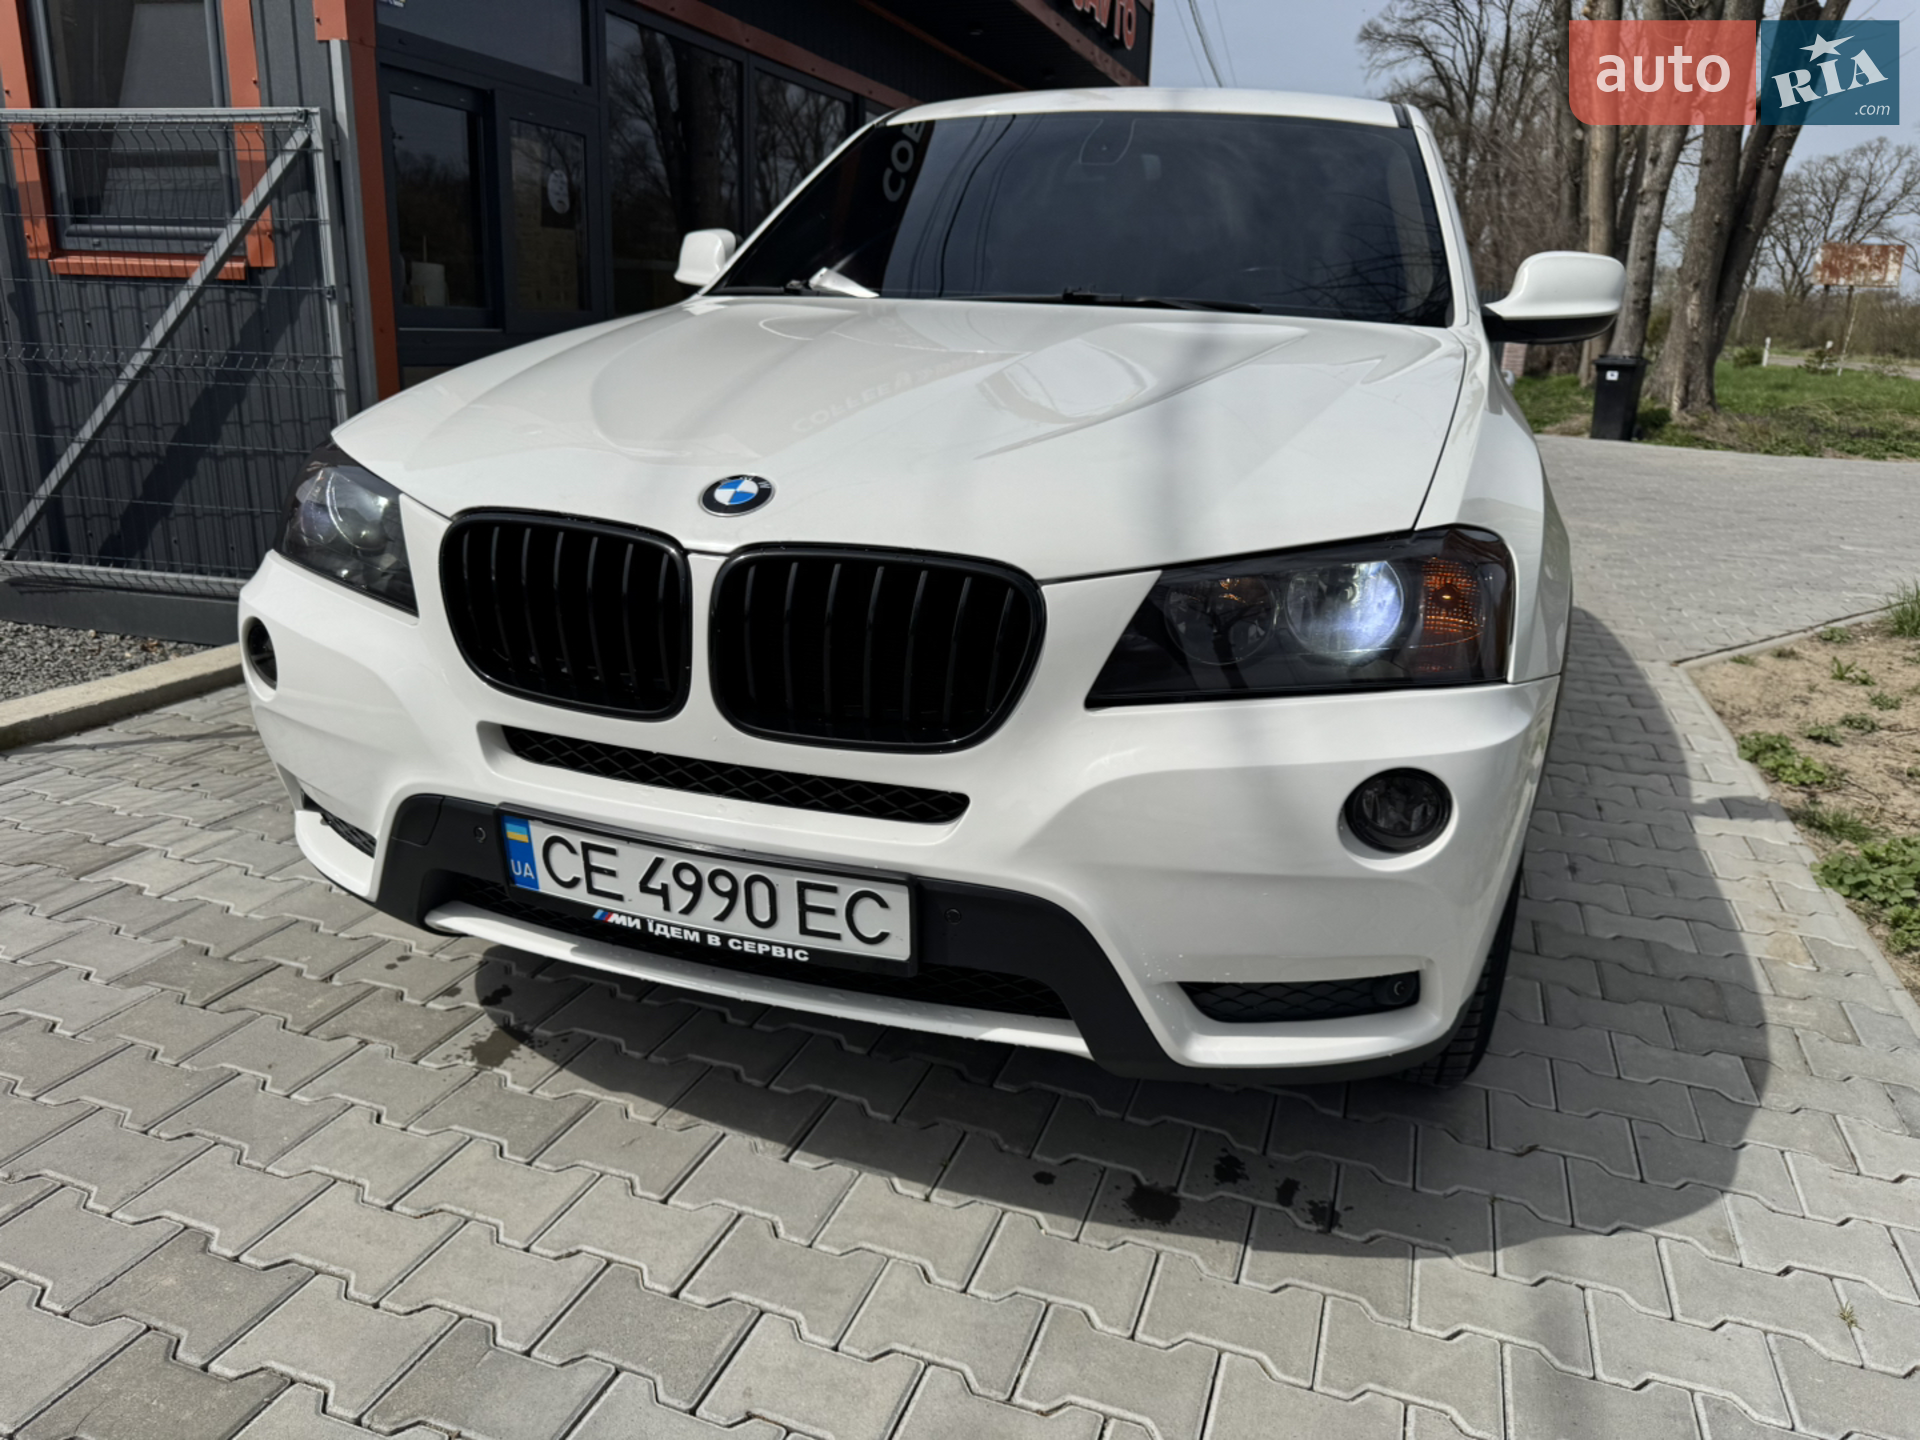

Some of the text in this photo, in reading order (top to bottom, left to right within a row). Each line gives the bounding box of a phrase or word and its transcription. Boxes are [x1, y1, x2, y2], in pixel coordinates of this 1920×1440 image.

[511, 860, 535, 880] UA
[542, 835, 891, 945] CE 4990 EC
[609, 913, 810, 962] МИ ЇДЕМ В СЕРВІС
